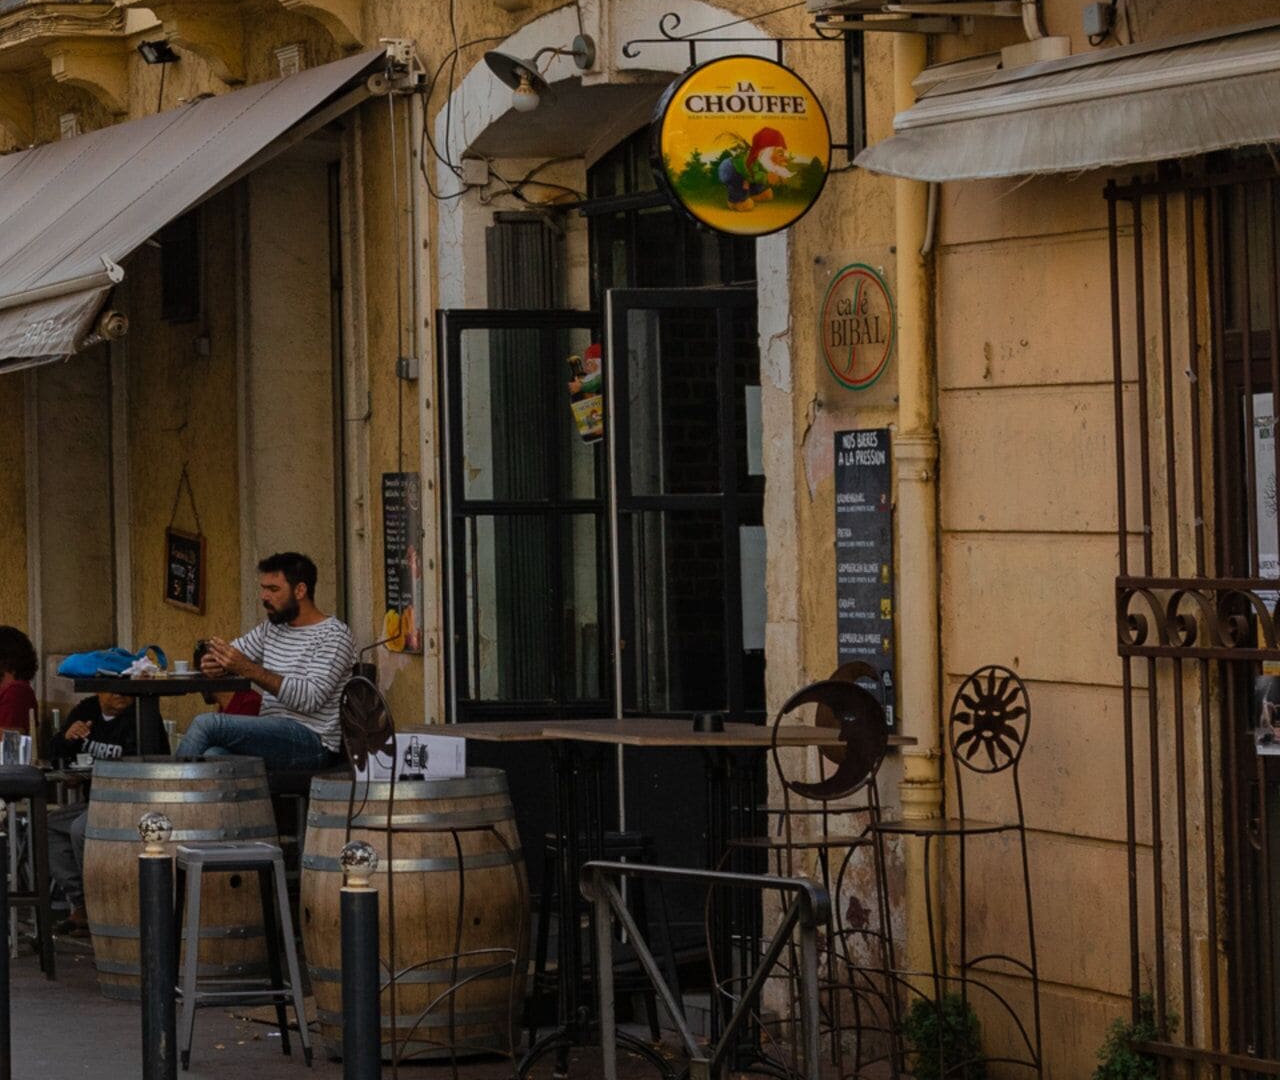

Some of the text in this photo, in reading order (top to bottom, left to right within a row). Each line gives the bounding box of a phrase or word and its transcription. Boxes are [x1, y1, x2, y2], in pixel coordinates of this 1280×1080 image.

[736, 82, 756, 93] LA
[685, 95, 806, 113] CHOUFFE
[831, 315, 886, 347] BIBAL
[842, 433, 856, 449] NOS
[838, 450, 886, 466] A LA PRESSION
